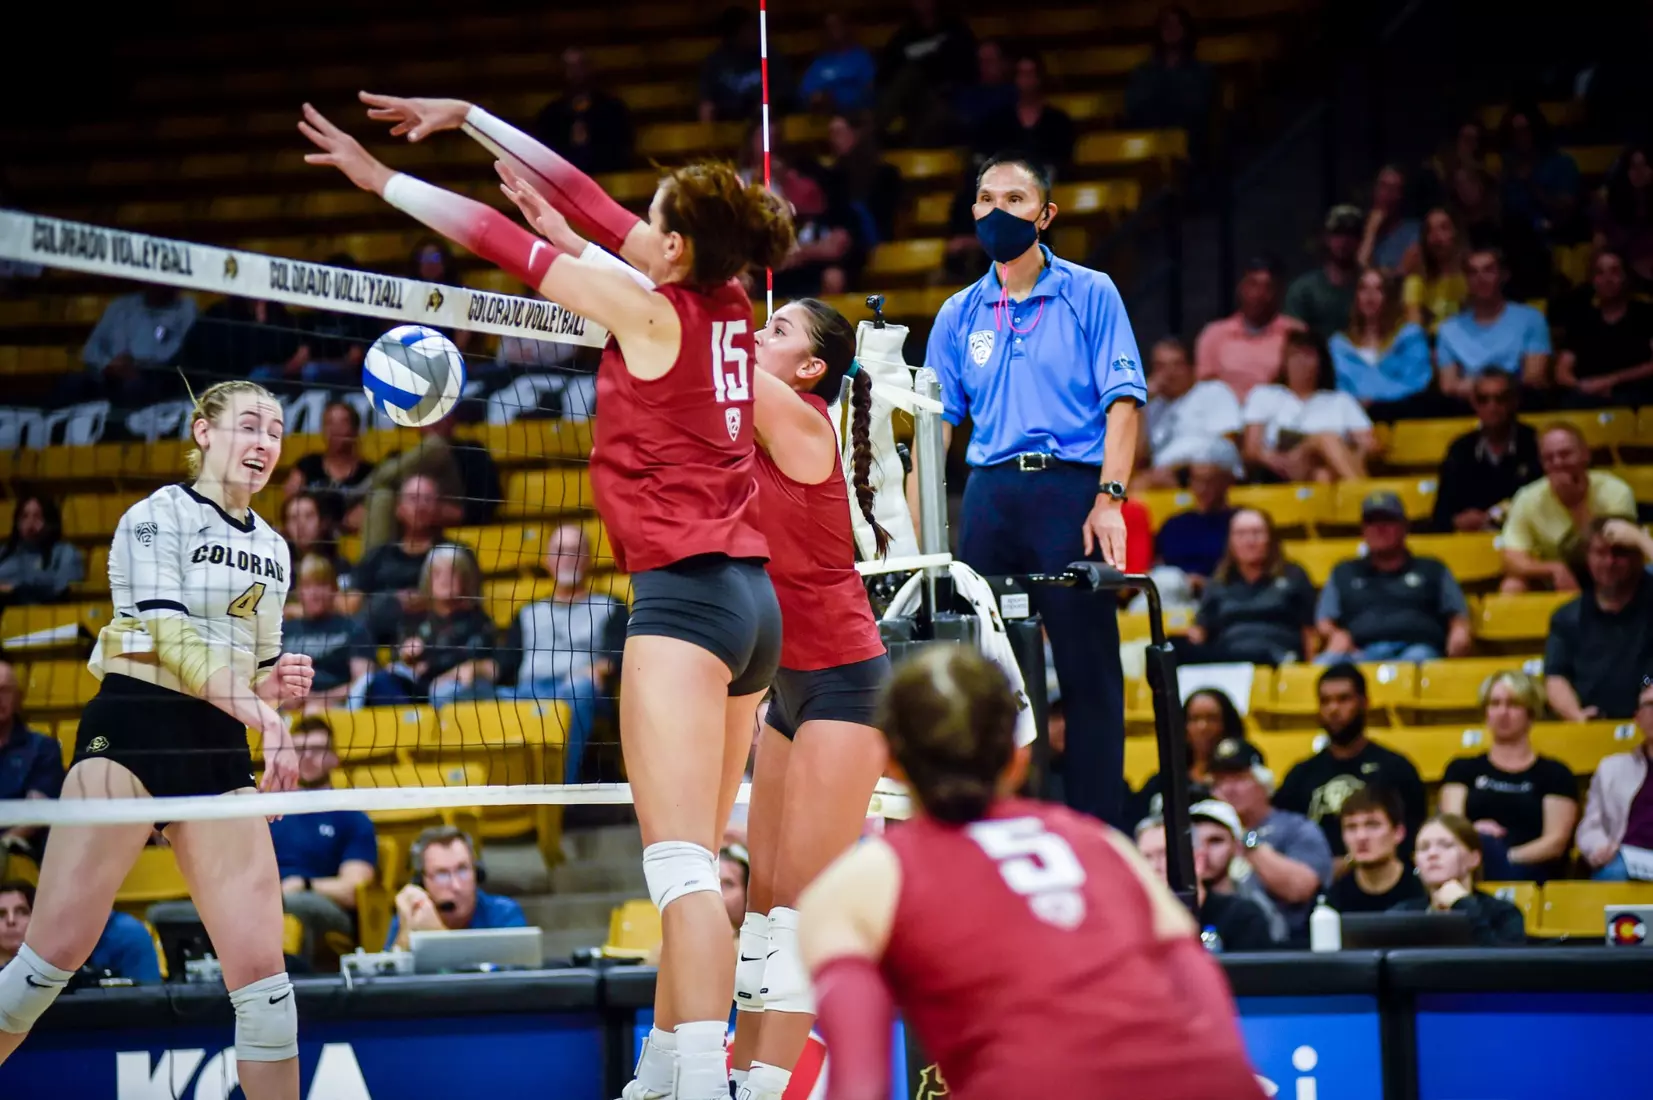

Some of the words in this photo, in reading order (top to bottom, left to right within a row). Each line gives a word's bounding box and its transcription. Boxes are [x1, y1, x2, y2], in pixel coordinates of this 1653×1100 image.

[523, 300, 585, 337] VOLLEYBALL
[711, 319, 748, 402] 15
[226, 581, 267, 618] 4
[966, 817, 1087, 894] 5
